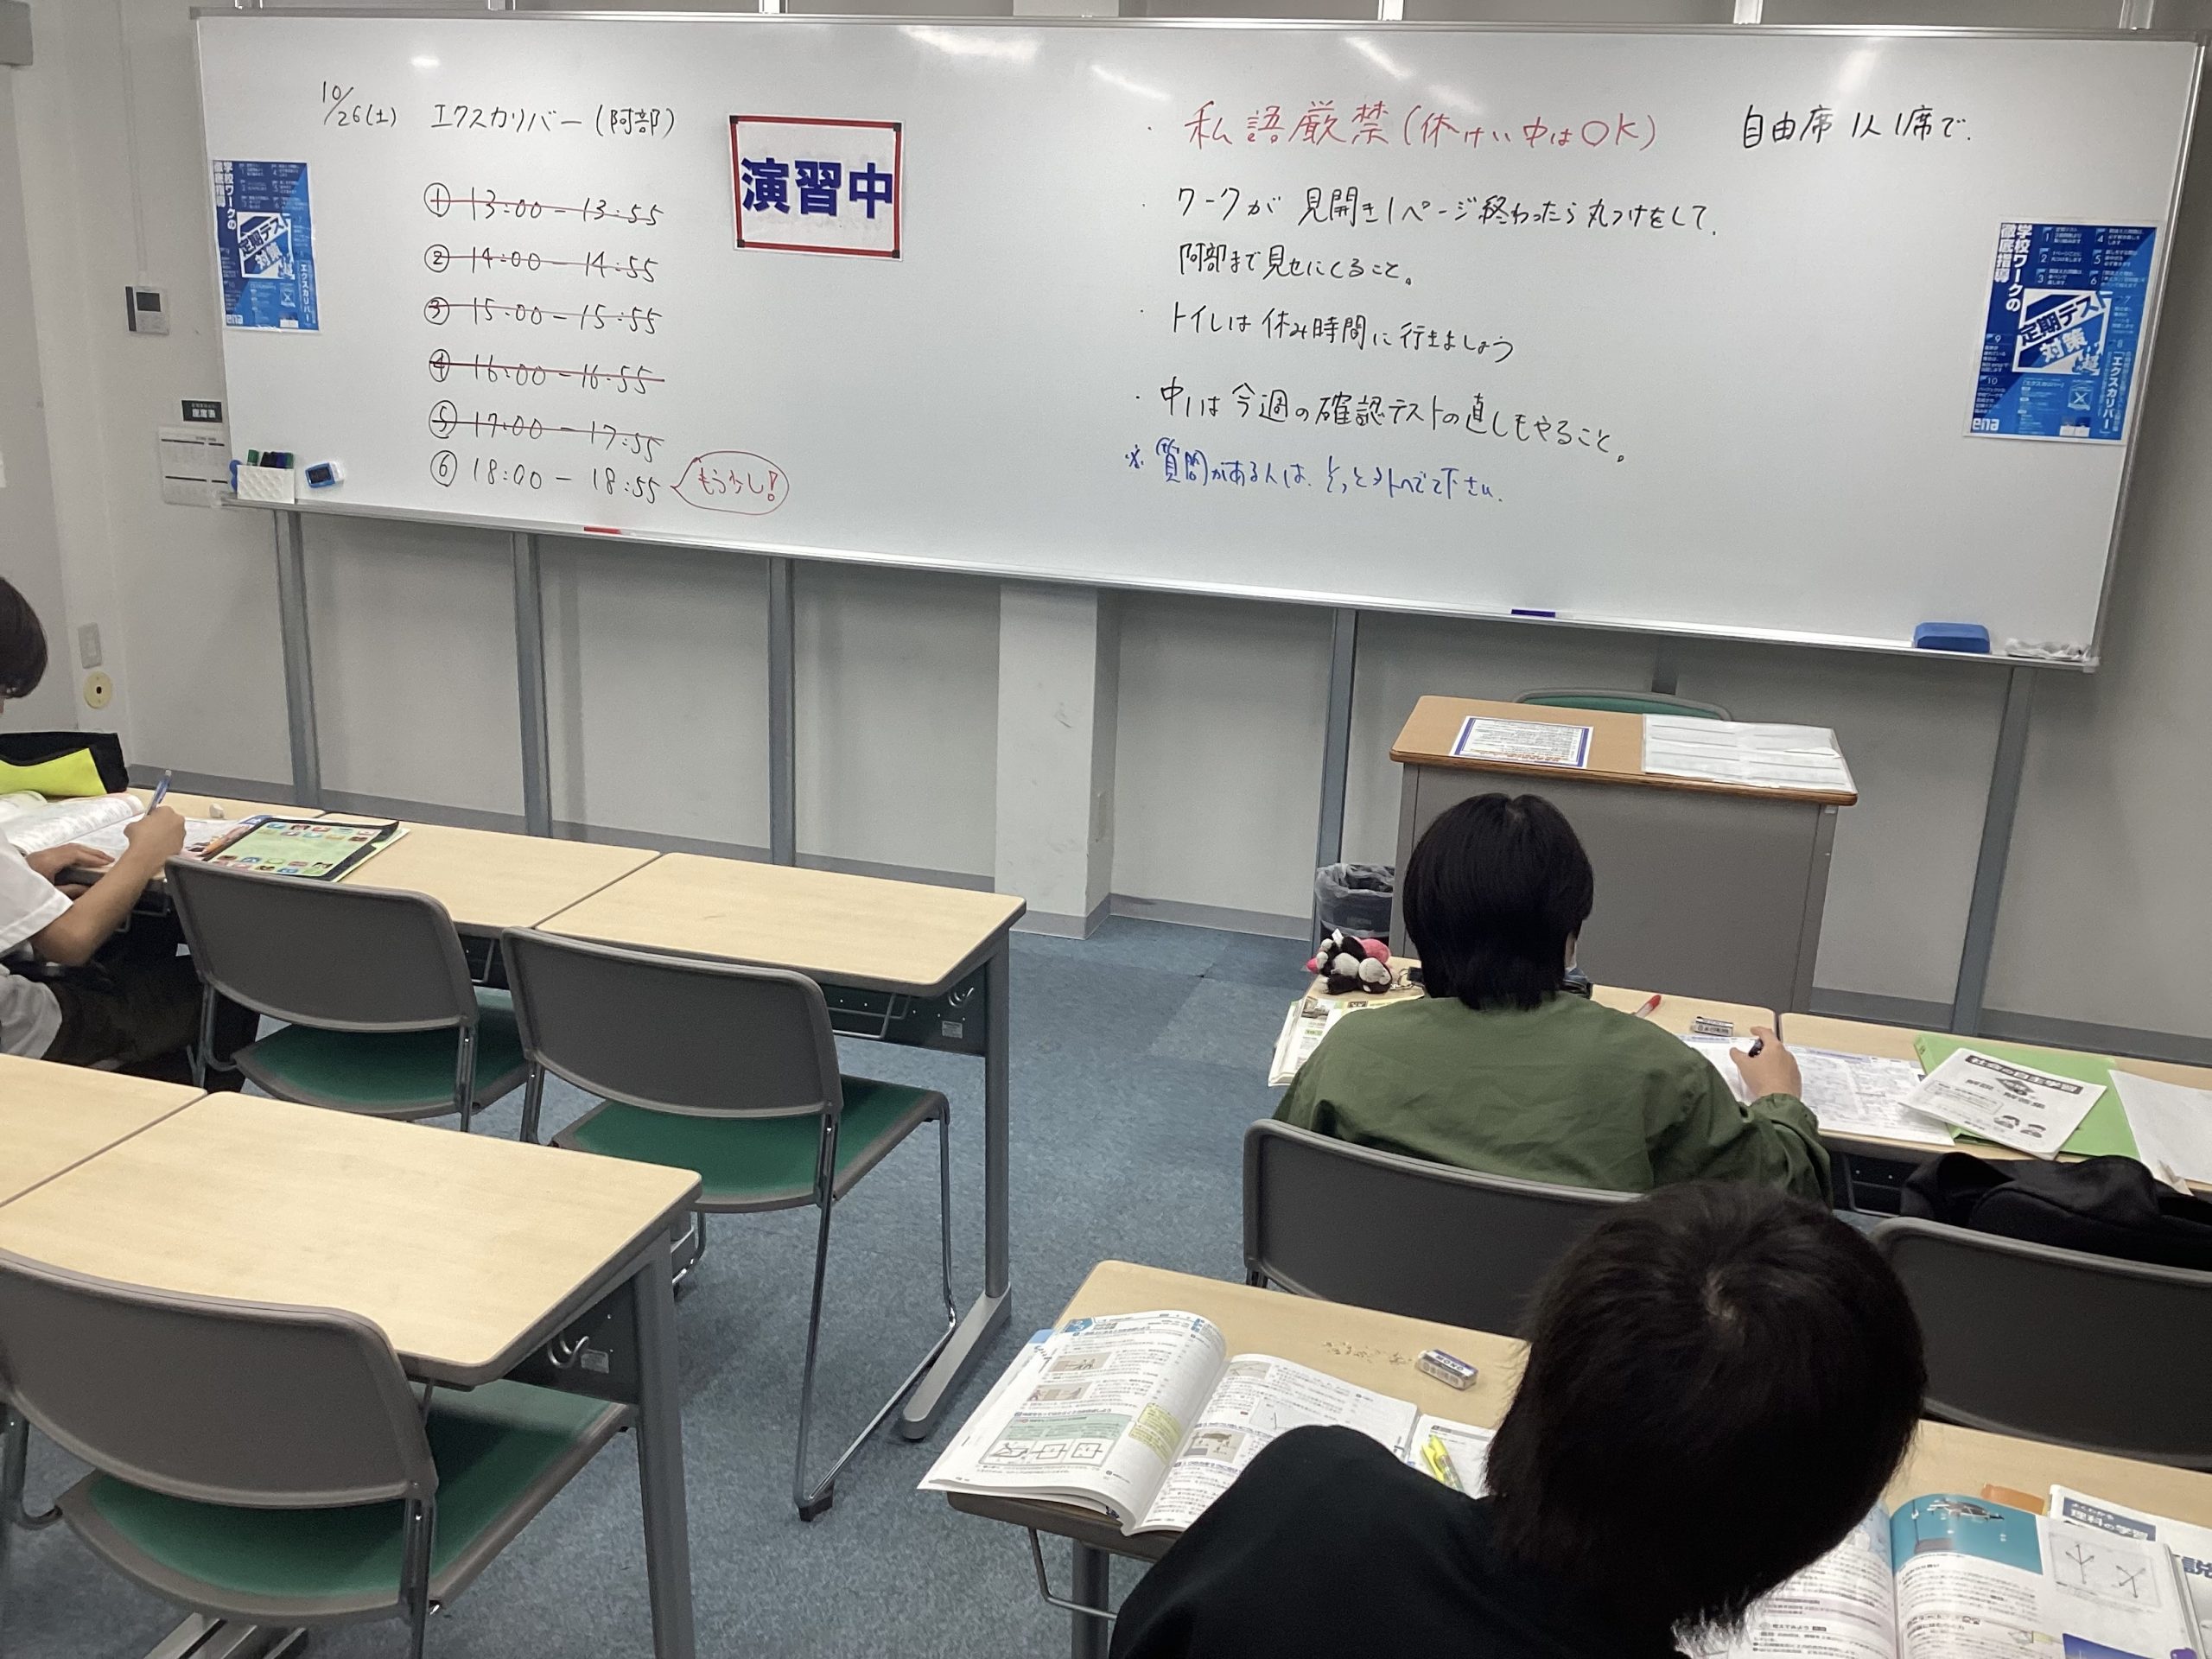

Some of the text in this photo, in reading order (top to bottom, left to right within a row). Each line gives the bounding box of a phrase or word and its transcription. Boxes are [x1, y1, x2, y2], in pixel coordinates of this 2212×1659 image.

[741, 157, 893, 219] 演習中
[2005, 224, 2032, 312] 学校ワークの
[2019, 289, 2113, 346] 定期テスト
[2040, 327, 2088, 363] 対策
[1971, 417, 2000, 431] ena
[1435, 1355, 1465, 1371] MONO
